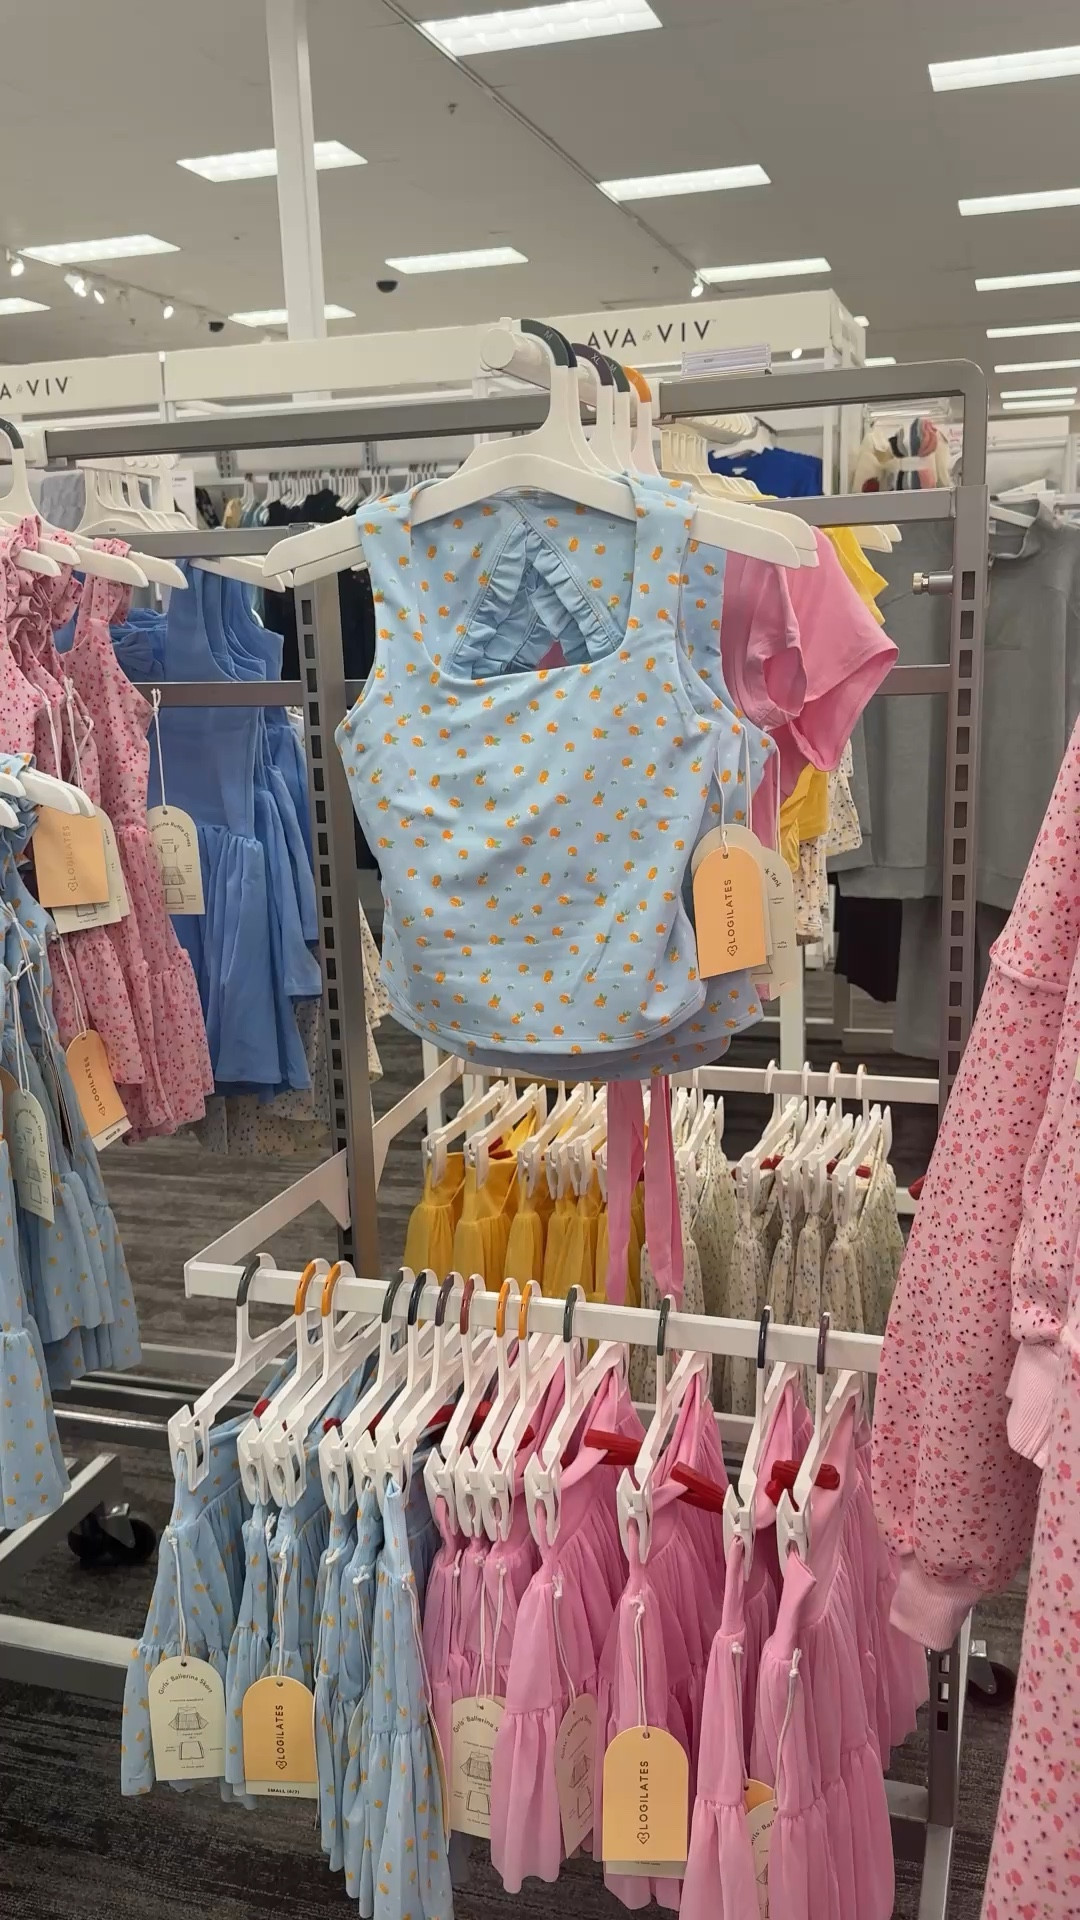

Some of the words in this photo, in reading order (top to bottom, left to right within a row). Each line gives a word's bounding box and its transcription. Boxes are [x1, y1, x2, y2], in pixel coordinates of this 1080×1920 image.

[587, 328, 637, 350] AVA
[657, 320, 710, 343] VIV
[591, 353, 601, 366] XL
[26, 376, 68, 397] VIV
[770, 872, 782, 888] Tank
[158, 1679, 169, 1695] Girls'
[170, 1673, 199, 1682] Ballerina
[199, 1678, 213, 1693] Skort
[452, 1717, 465, 1734] Girls'
[466, 1715, 494, 1729] Ballerina
